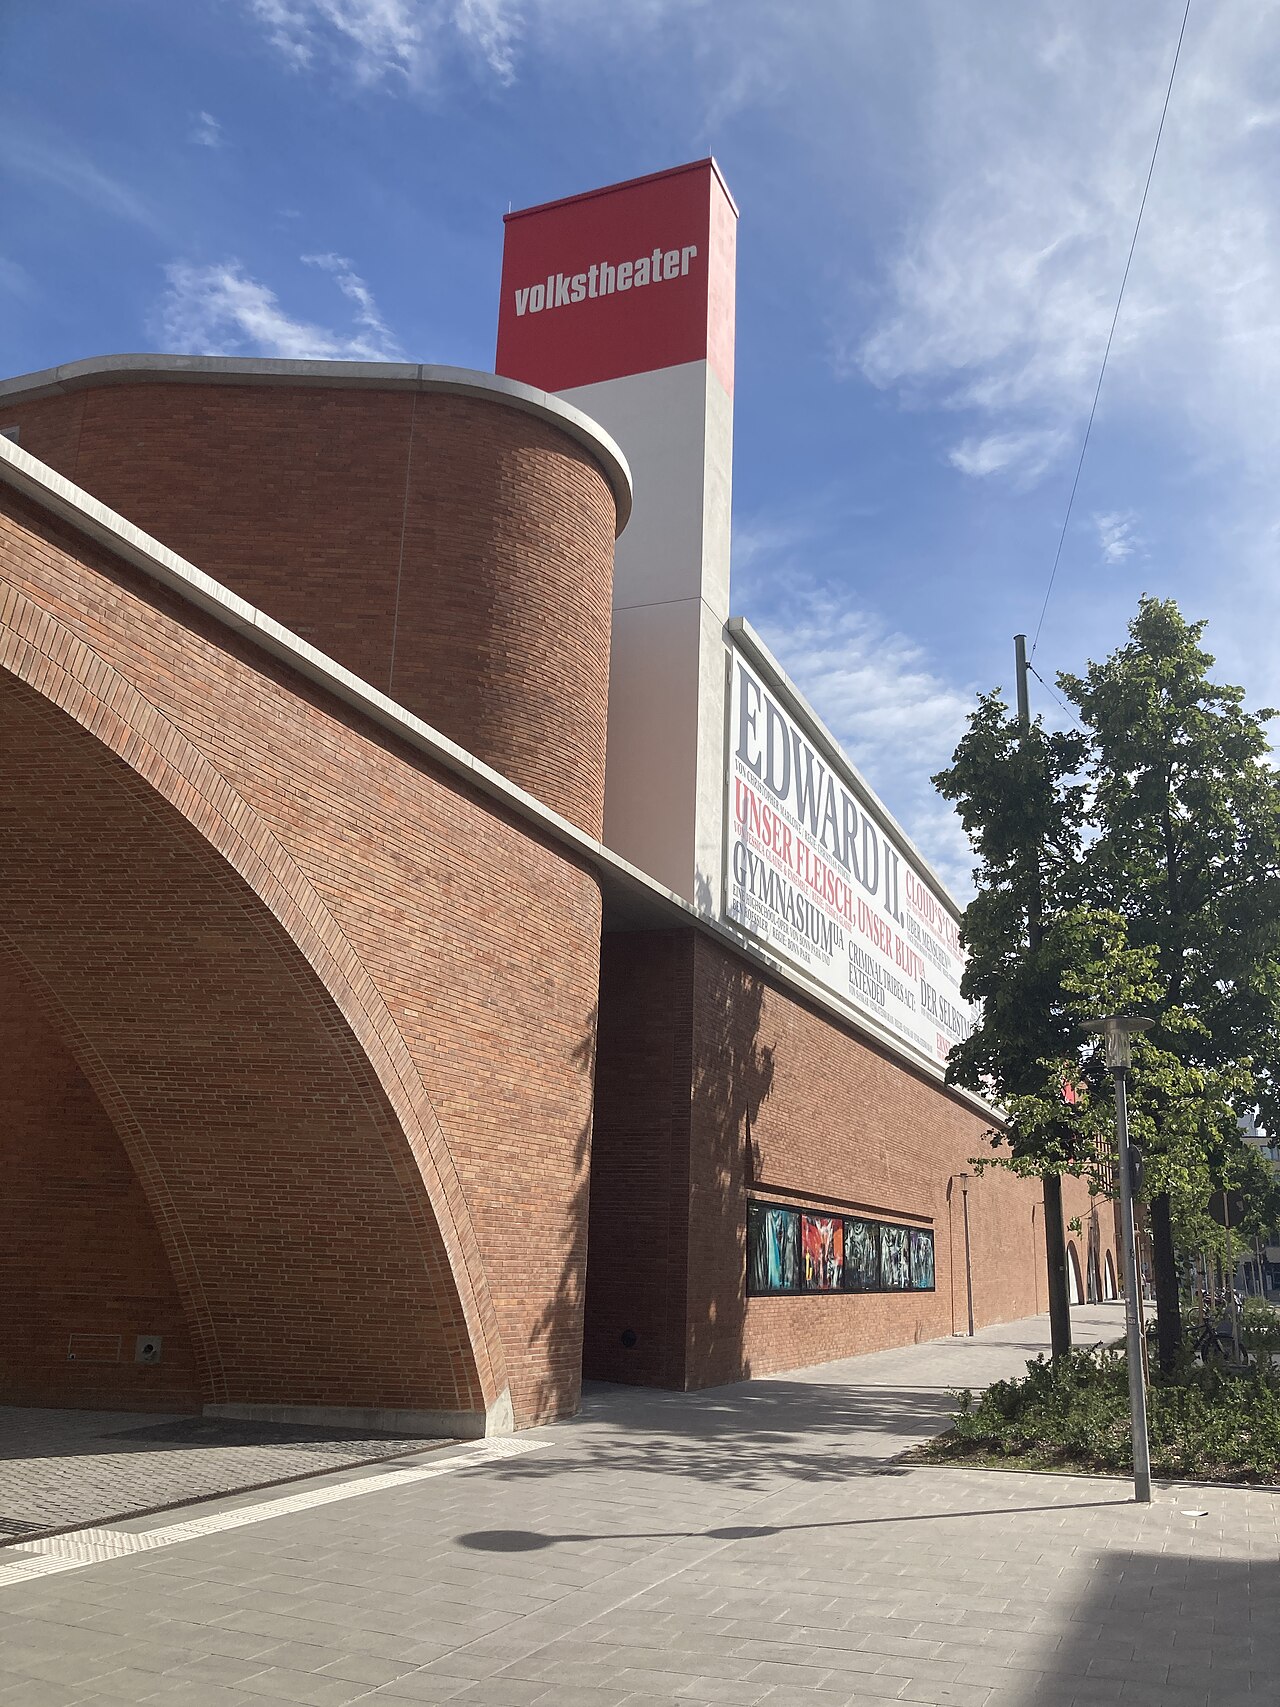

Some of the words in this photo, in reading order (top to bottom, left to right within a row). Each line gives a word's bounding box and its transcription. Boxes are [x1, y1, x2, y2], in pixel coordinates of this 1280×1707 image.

[514, 245, 698, 317] volkstheater
[735, 660, 879, 896] EDWARD
[735, 776, 793, 869] UNSER
[796, 837, 856, 927] FLEISCH,
[857, 896, 893, 960] UNSER
[848, 961, 885, 1006] EXTENDED
[849, 940, 882, 985] CRIMINAL
[883, 968, 904, 1003] TRIBES
[920, 976, 937, 1017] DER
